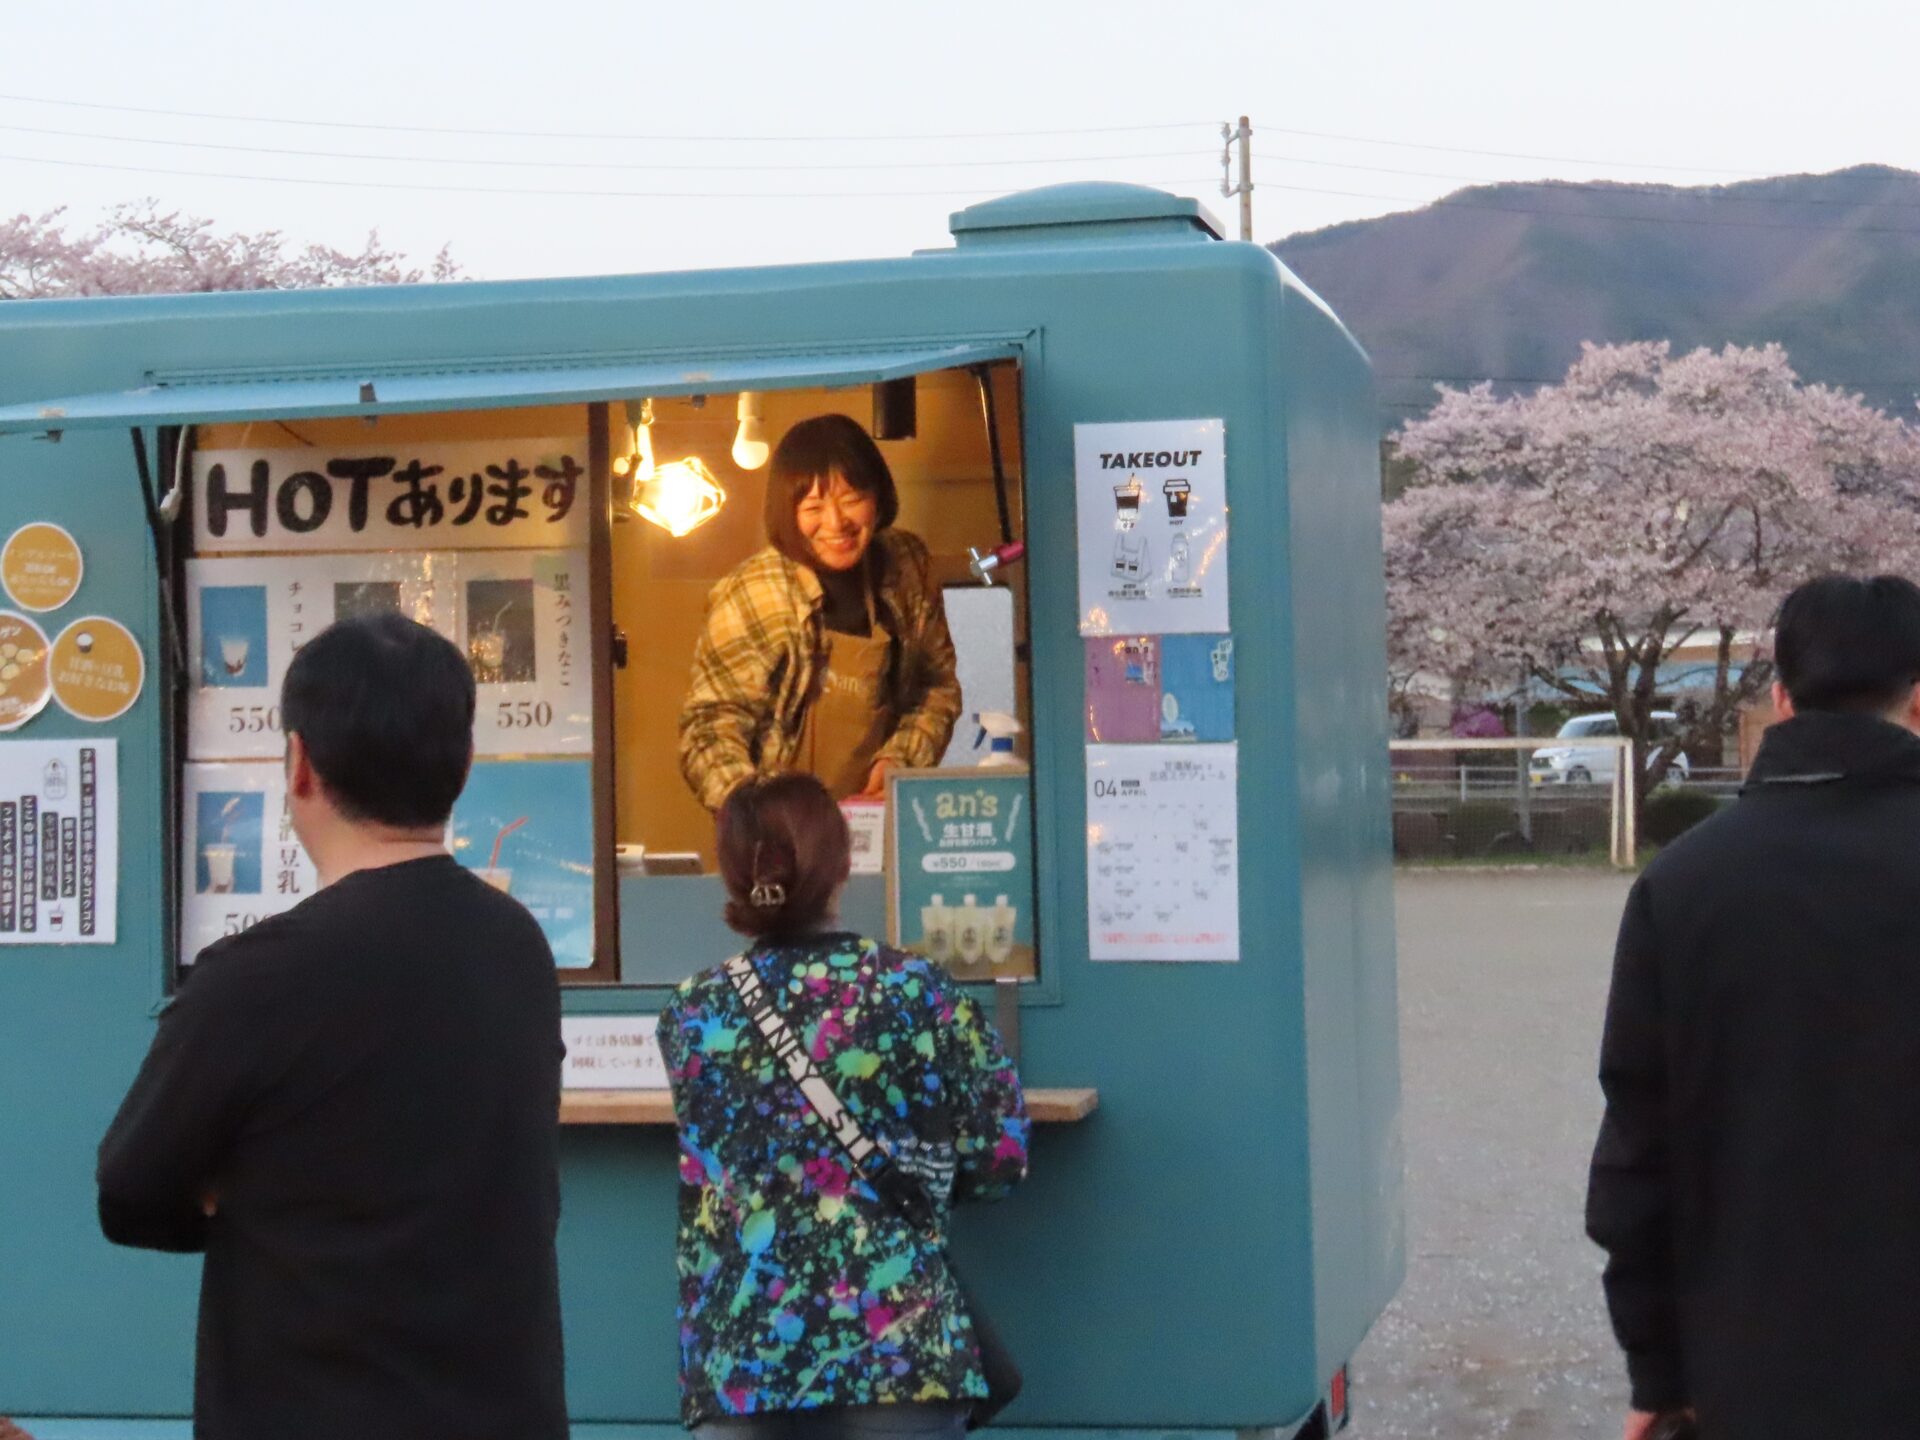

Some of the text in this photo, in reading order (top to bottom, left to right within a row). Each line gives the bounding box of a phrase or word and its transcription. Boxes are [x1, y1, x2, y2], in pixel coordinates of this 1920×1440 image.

[1100, 451, 1202, 469] TAKEOUT
[229, 706, 283, 733] 550
[497, 701, 552, 728] 550
[1094, 779, 1117, 798] 04
[936, 789, 997, 819] an's
